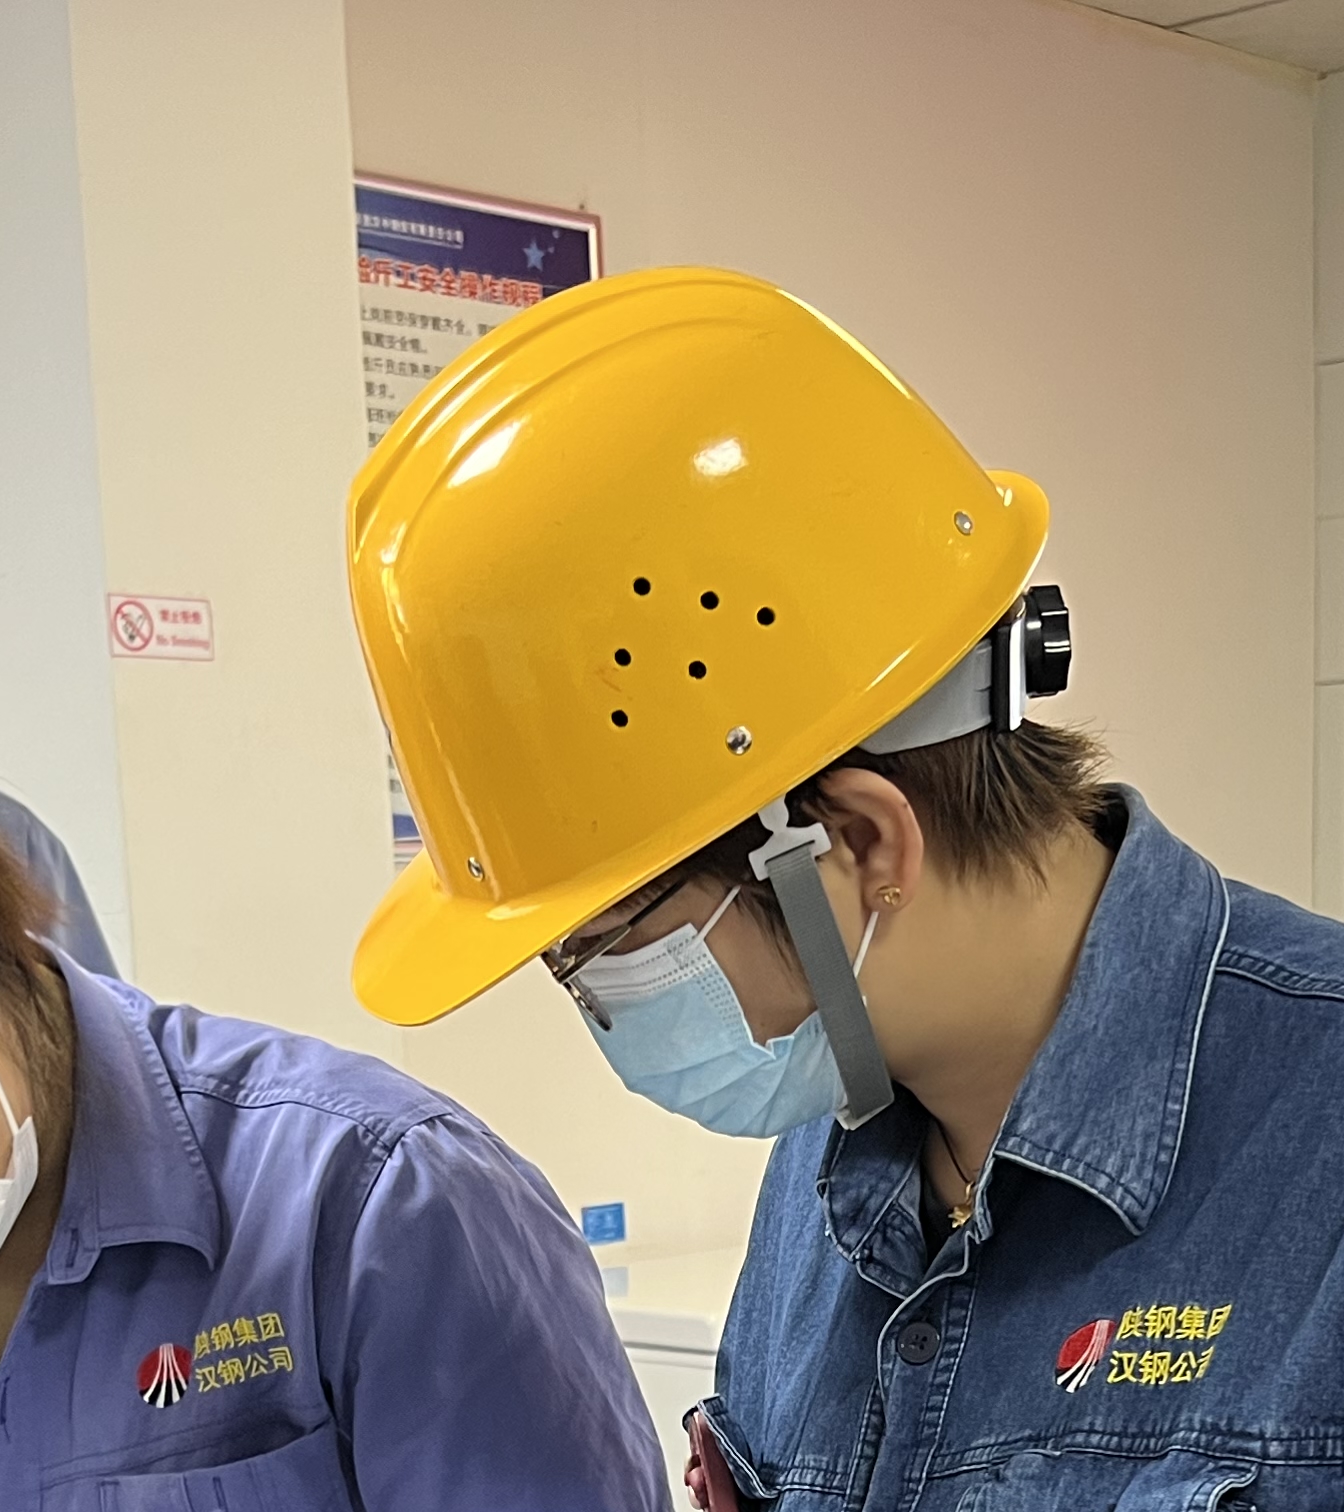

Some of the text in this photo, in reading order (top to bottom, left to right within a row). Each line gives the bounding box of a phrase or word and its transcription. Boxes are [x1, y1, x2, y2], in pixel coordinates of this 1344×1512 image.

[1115, 1303, 1233, 1341] 陕钢集团
[194, 1345, 294, 1393] 汉钢公司
